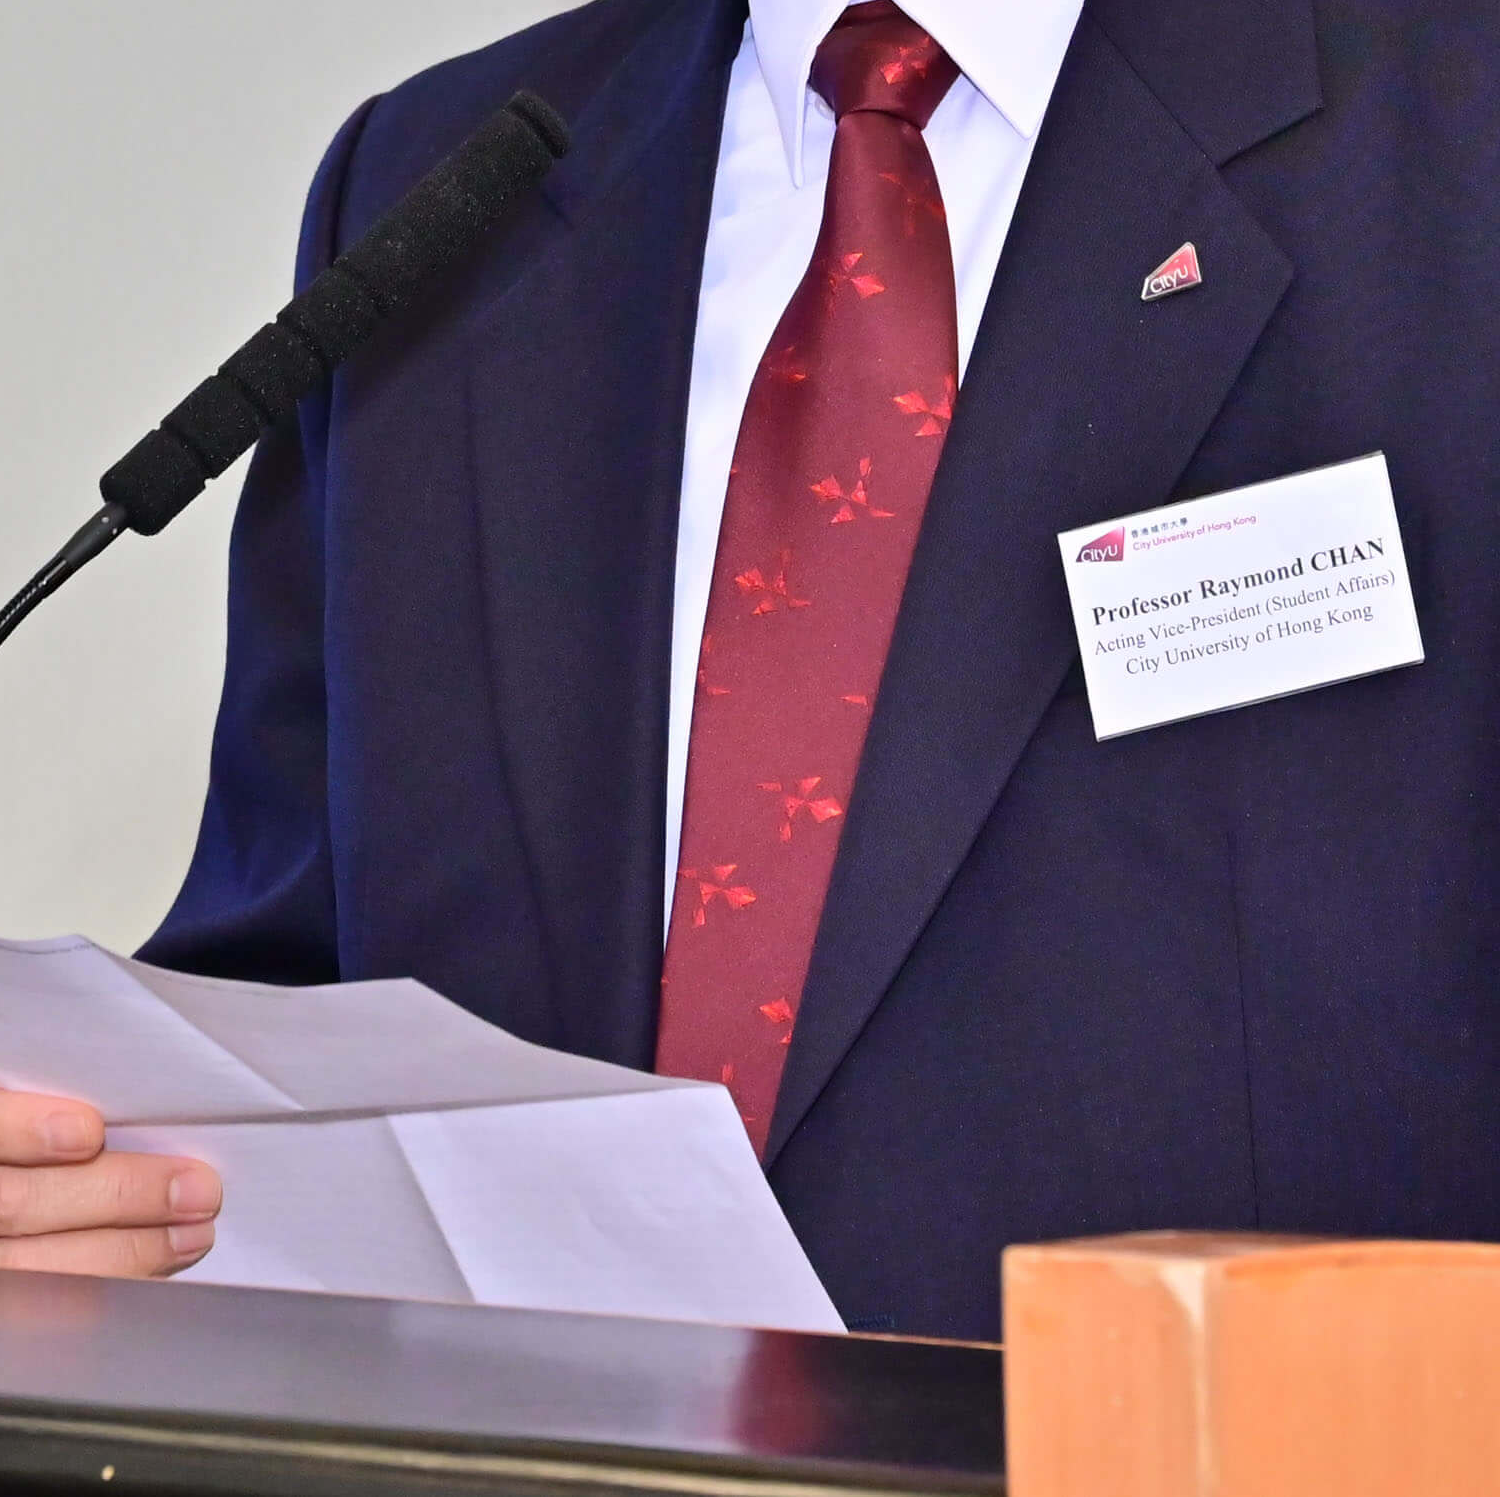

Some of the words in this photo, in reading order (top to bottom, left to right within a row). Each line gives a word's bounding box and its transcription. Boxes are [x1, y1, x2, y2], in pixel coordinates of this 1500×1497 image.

[1081, 543, 1119, 563] CityU
[1133, 540, 1151, 550] City
[1152, 530, 1195, 546] University
[1196, 524, 1206, 535] of
[1206, 520, 1232, 532] Hong
[1233, 515, 1257, 526] Kong
[1092, 588, 1192, 626] Professor
[1198, 557, 1304, 599] Raymond
[1310, 537, 1384, 572] CHAN
[1095, 633, 1146, 656] Acting
[1148, 603, 1261, 641] Vice-President
[1265, 586, 1331, 616] (Student
[1336, 569, 1396, 597] Affairs)
[1126, 655, 1160, 675] City
[1165, 634, 1250, 666] University
[1255, 624, 1274, 643] of
[1277, 617, 1324, 639] Hong
[1327, 605, 1374, 626] Kong
